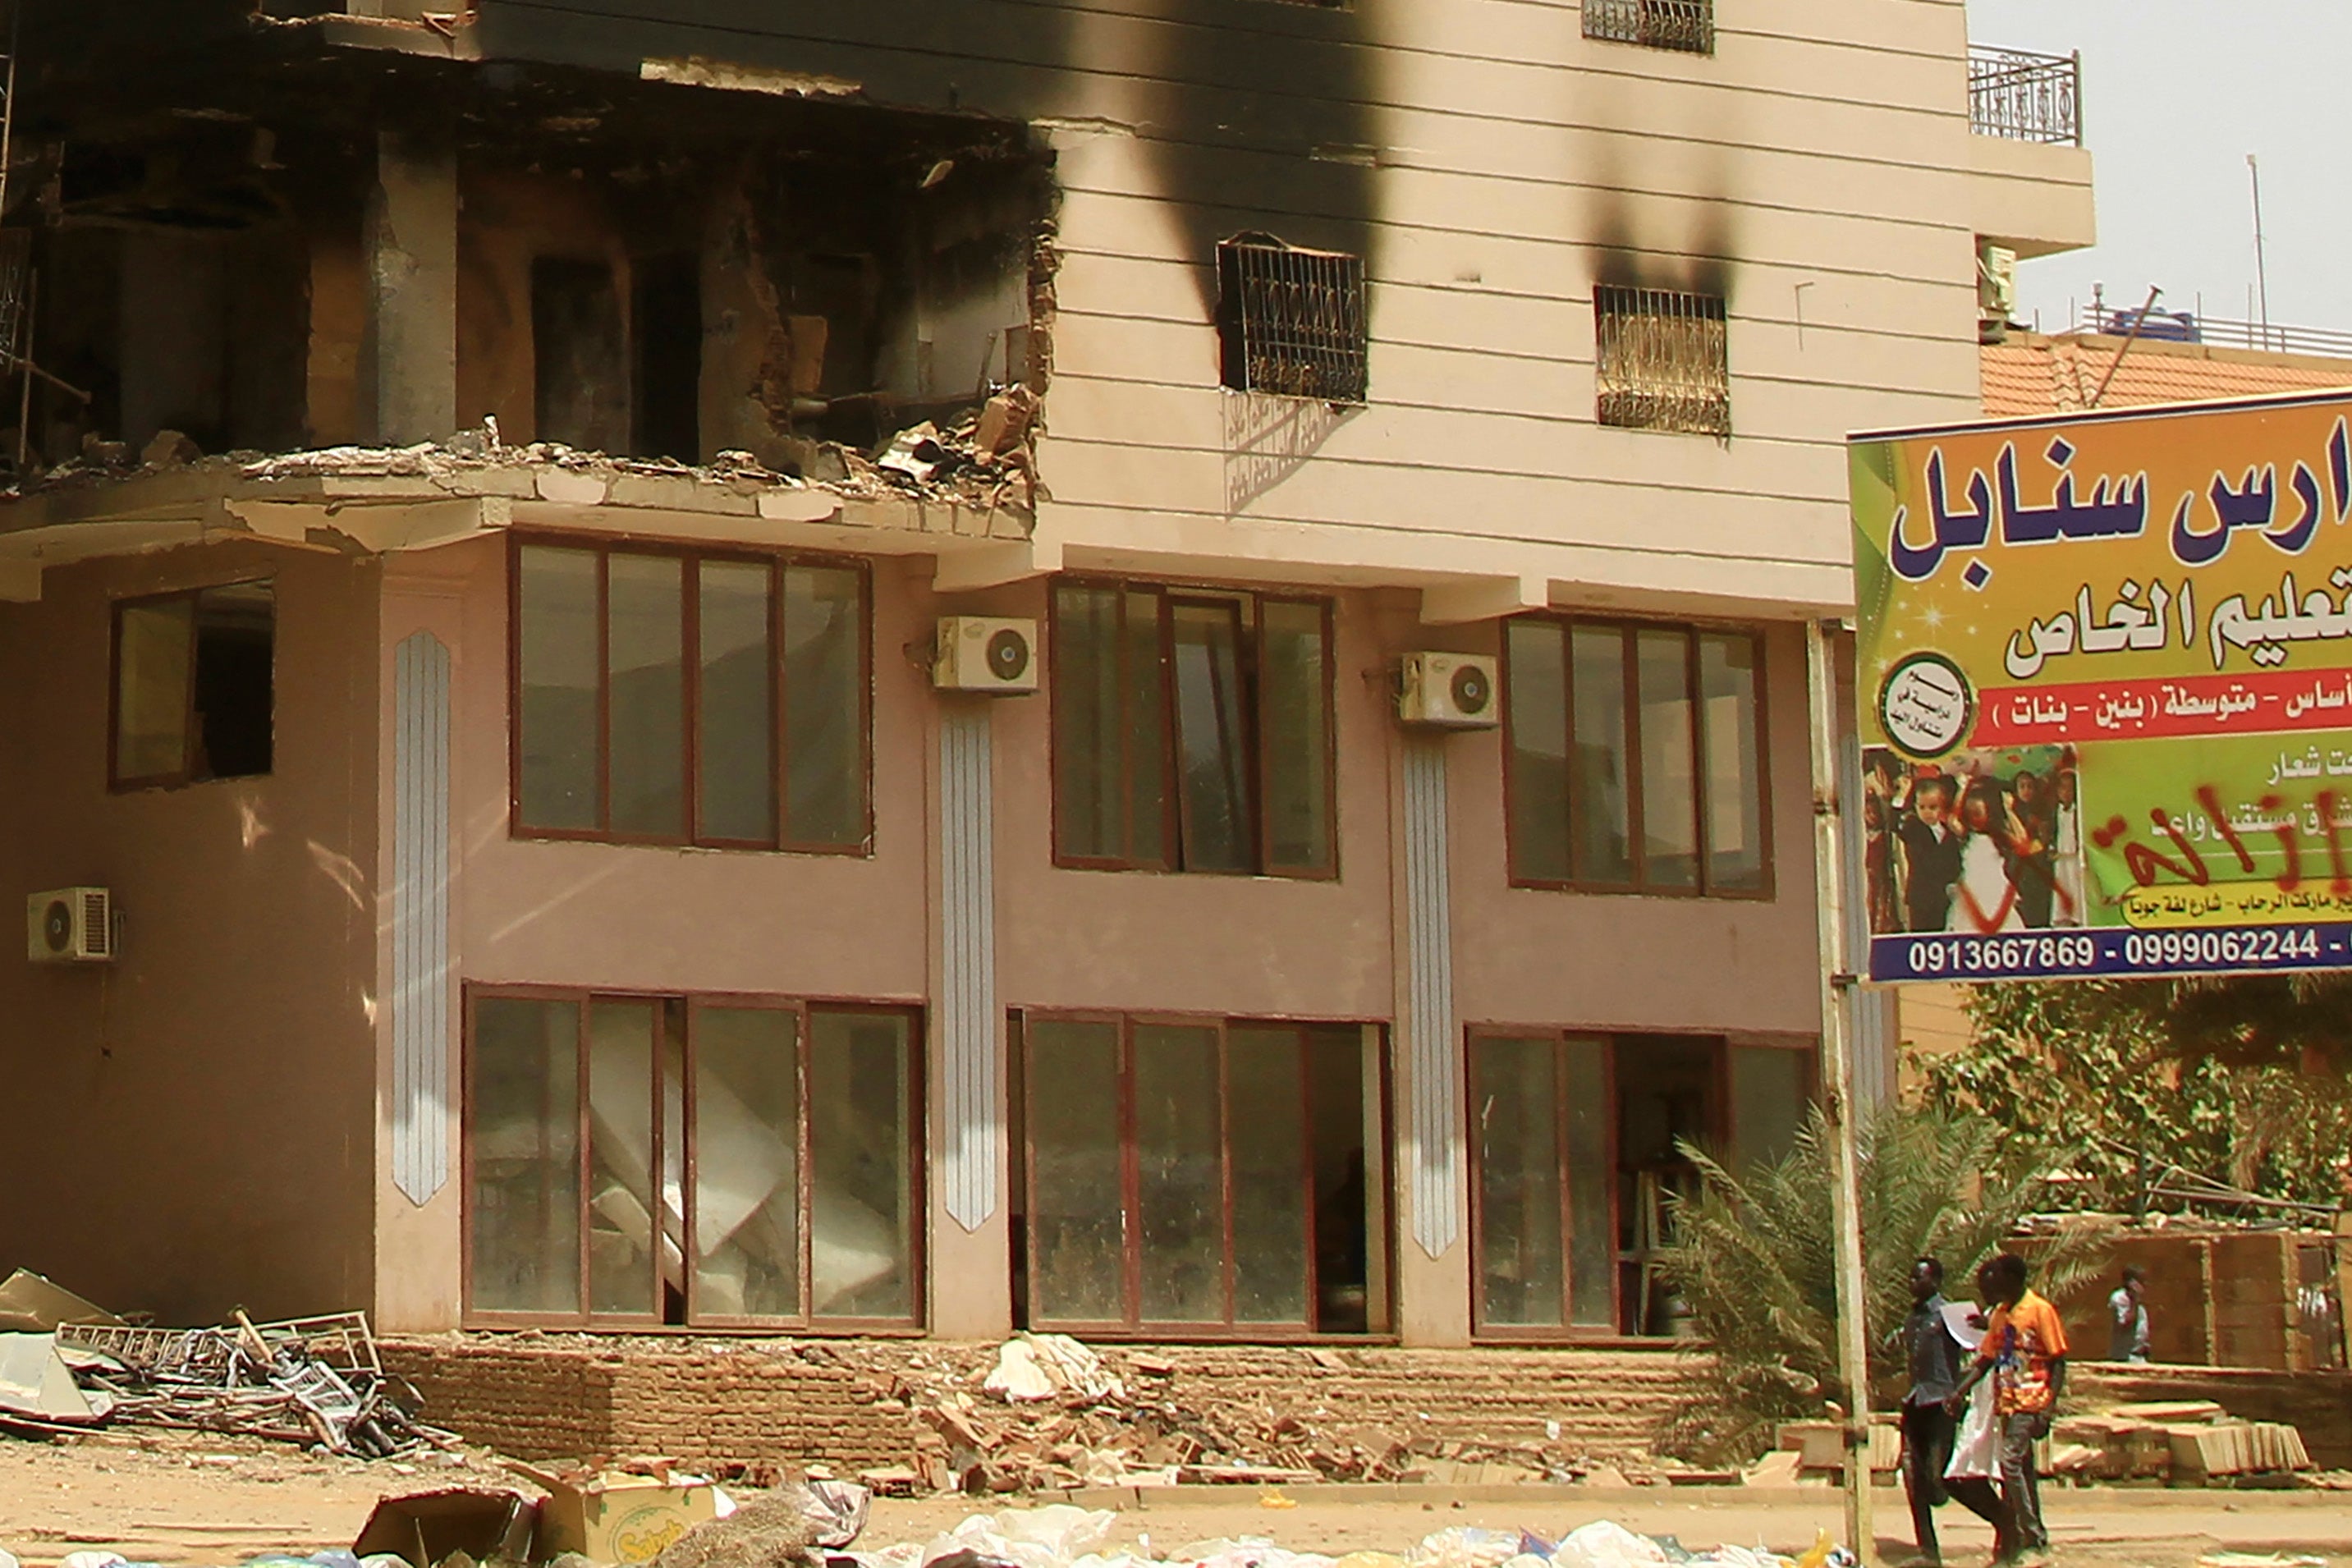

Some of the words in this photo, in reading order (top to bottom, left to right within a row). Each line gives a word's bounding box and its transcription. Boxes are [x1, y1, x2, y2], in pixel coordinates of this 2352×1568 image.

[1888, 434, 2149, 592] سنابل
[2004, 578, 2194, 679] الخاص
[2161, 684, 2257, 722] متوسطة
[2266, 745, 2322, 786] شعار
[1909, 935, 2094, 972] 0913667869
[2125, 928, 2320, 965] 0999062244
